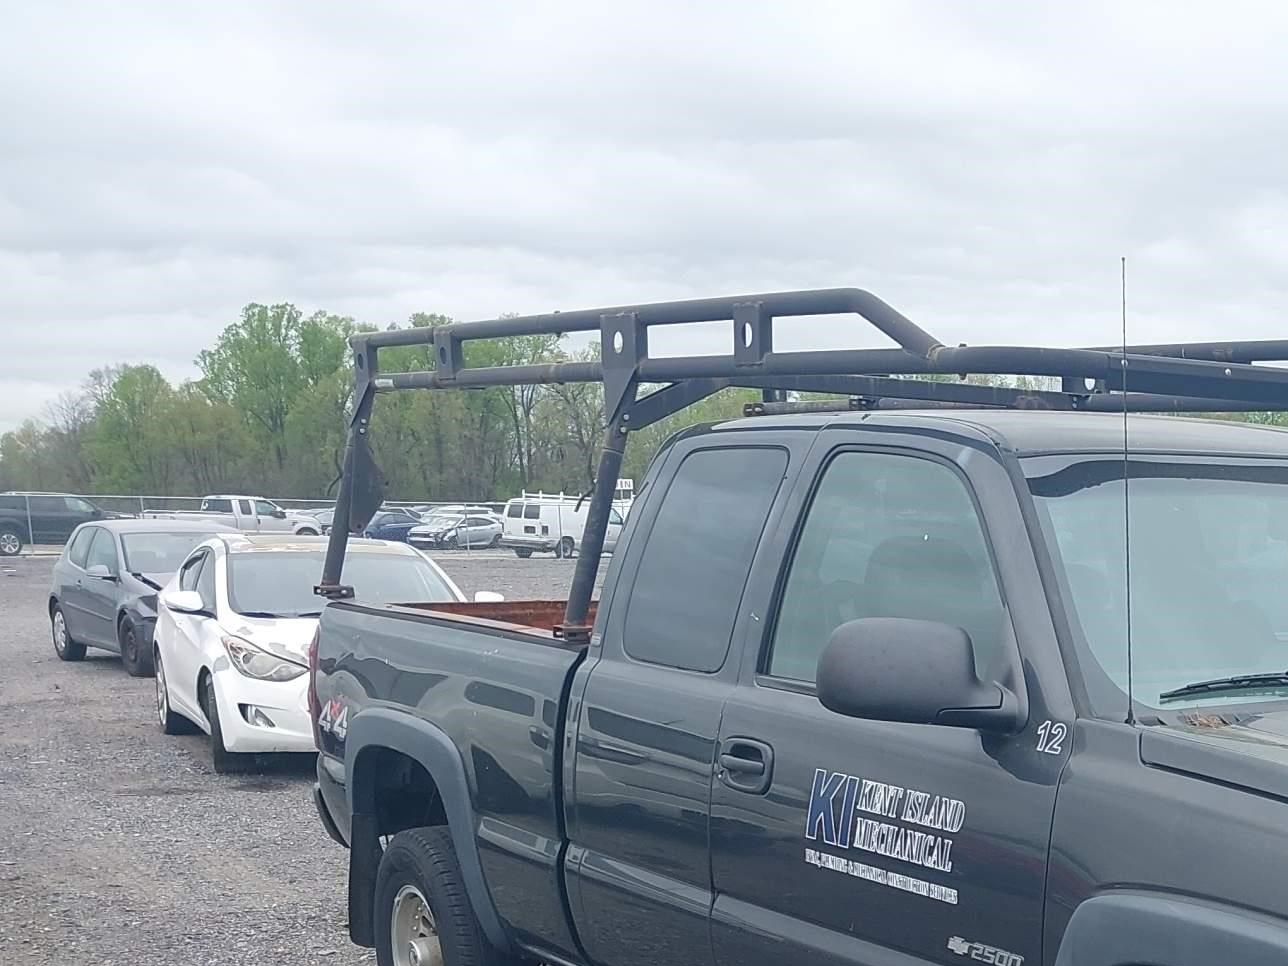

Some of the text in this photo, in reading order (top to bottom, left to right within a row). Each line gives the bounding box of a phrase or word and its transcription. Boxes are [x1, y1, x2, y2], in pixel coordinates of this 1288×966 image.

[1036, 720, 1067, 755] 12
[805, 768, 859, 849] KI
[856, 779, 966, 833] KENT ISLAND
[852, 817, 952, 873] MECHANICAL
